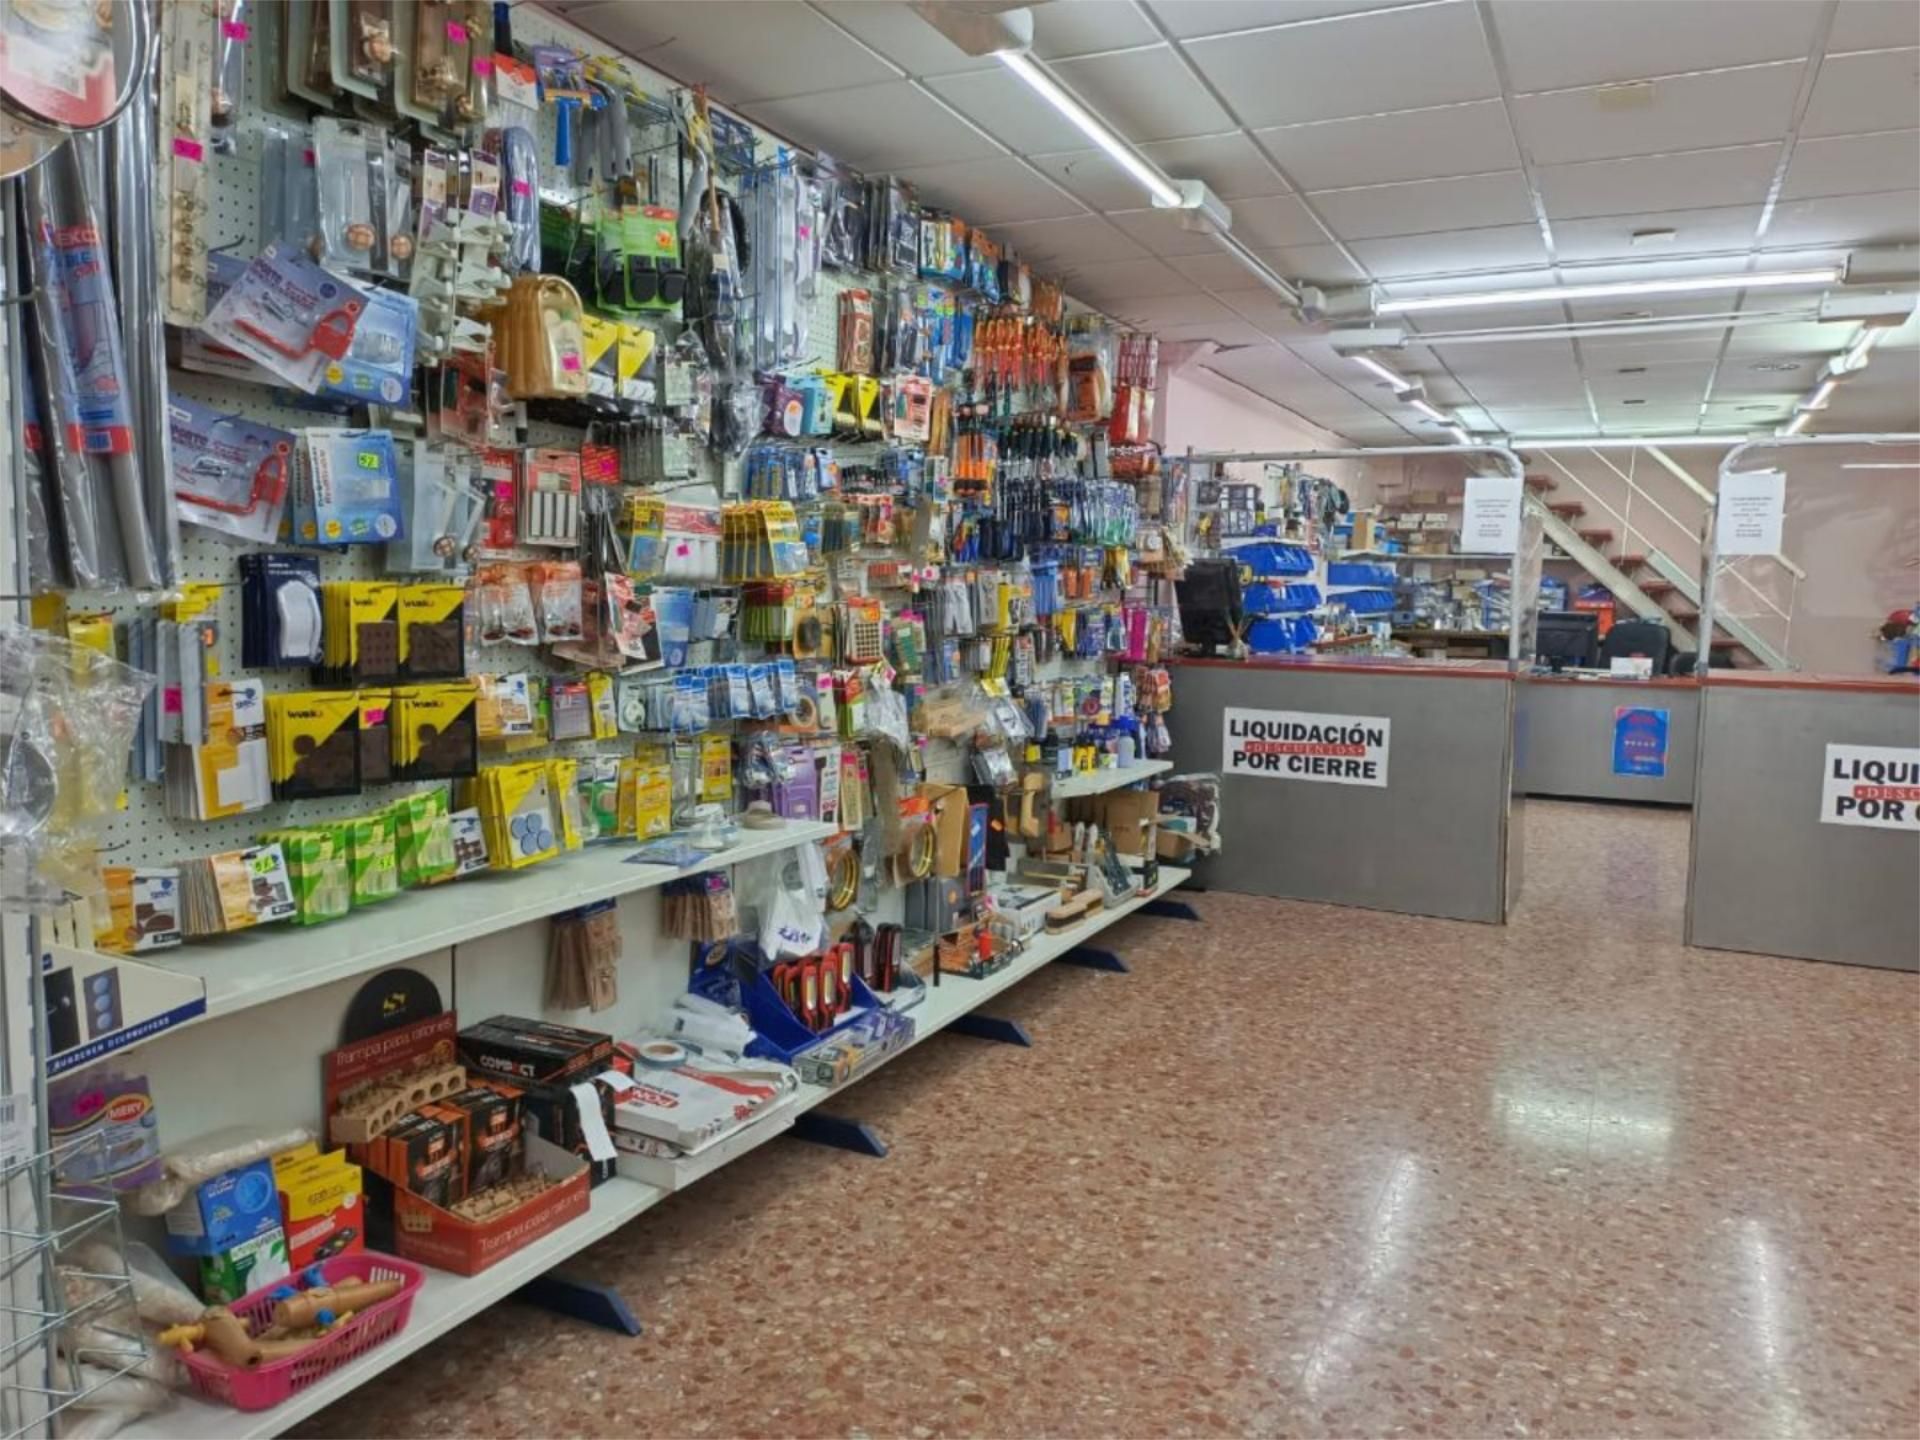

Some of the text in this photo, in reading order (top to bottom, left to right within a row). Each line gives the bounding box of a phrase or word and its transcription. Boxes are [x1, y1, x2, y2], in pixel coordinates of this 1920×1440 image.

[1230, 718, 1383, 747] LIQUIDACIÓN
[1233, 750, 1377, 780] POR CIERRE
[1836, 795, 1905, 822] POR
